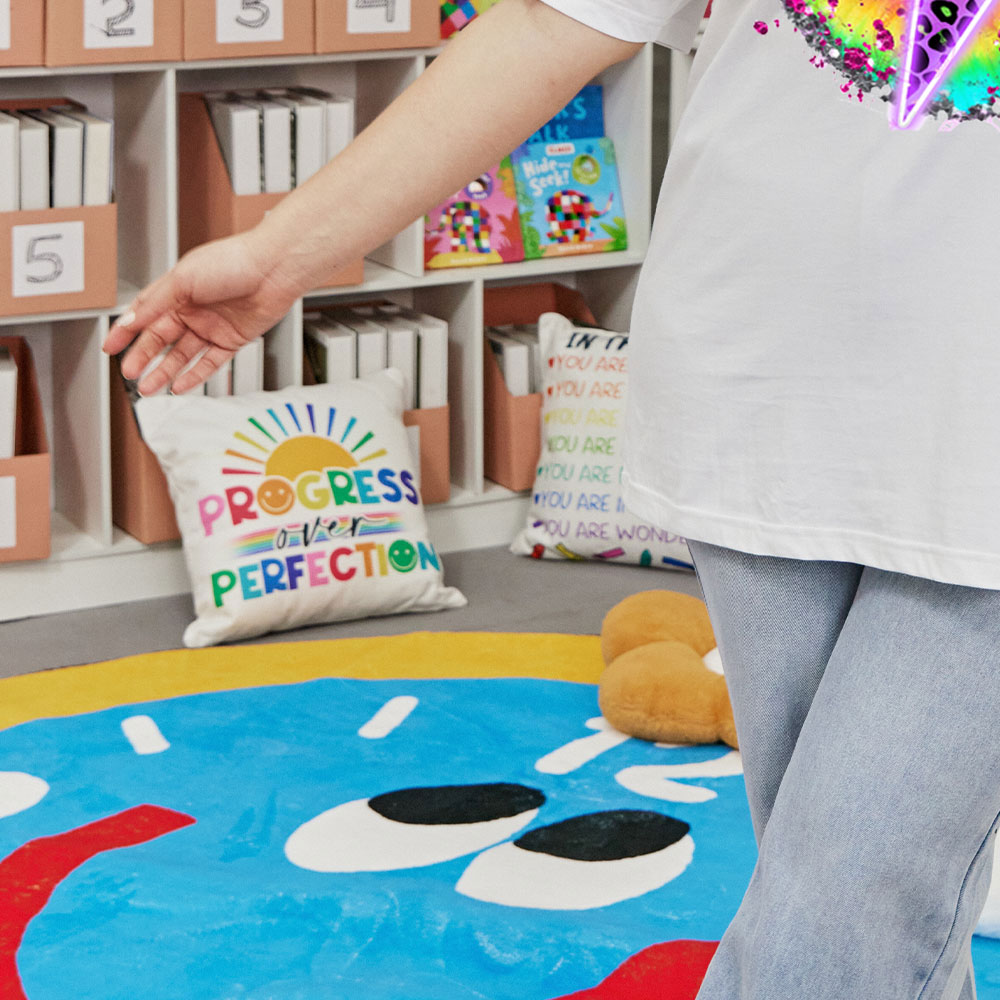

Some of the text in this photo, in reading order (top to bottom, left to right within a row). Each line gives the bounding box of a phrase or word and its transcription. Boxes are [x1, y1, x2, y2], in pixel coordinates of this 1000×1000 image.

[522, 157, 557, 179] Hide
[529, 170, 570, 197] Seek!
[26, 233, 64, 283] 5
[566, 332, 599, 350] IN
[557, 354, 629, 373] YOU ARE
[557, 380, 624, 400] YOU ARE
[586, 407, 620, 427] ARE
[583, 435, 617, 455] ARE
[543, 463, 574, 481] YOU
[579, 464, 614, 484] ARE
[197, 468, 419, 537] PROGRESS
[540, 491, 572, 510] YOU
[577, 492, 611, 512] ARE
[276, 514, 388, 549] over
[576, 520, 610, 541] ARE
[211, 539, 441, 608] PERFECTION
